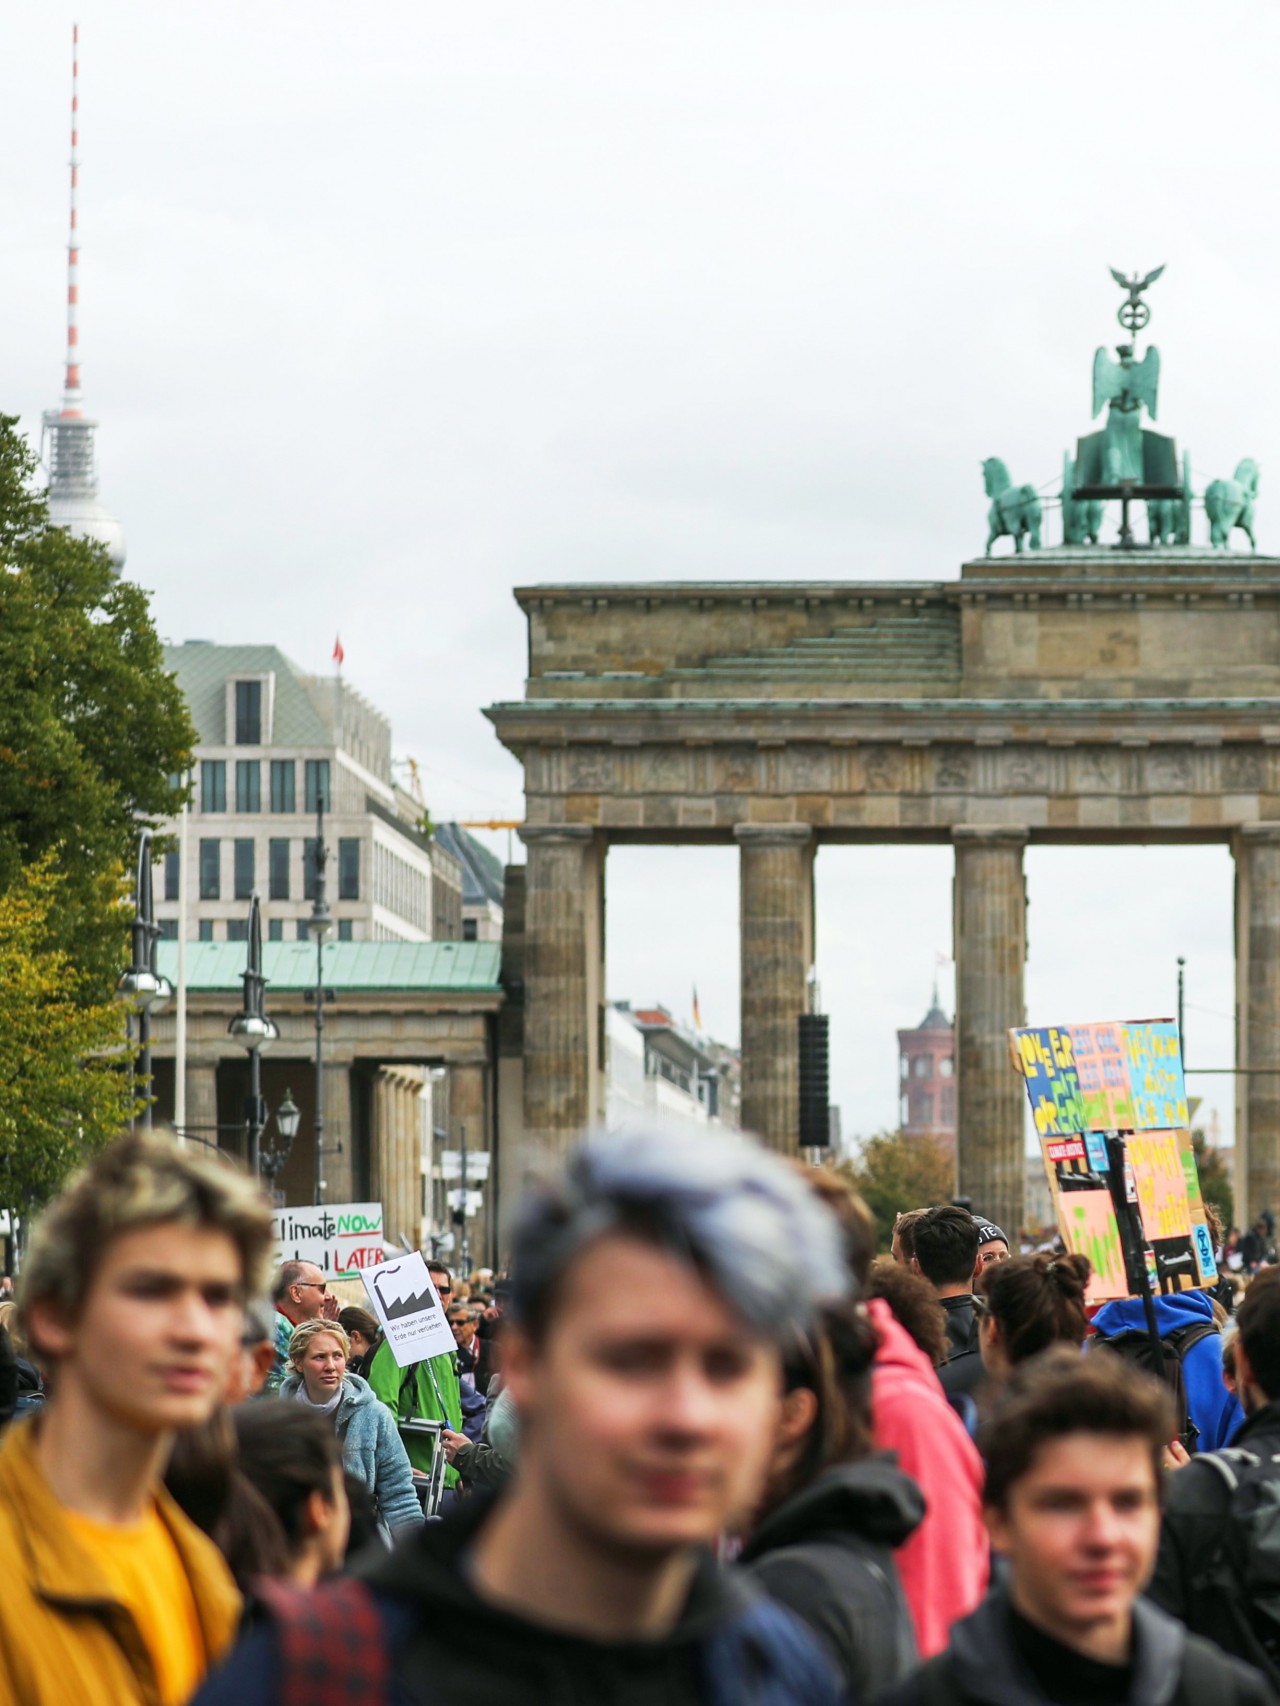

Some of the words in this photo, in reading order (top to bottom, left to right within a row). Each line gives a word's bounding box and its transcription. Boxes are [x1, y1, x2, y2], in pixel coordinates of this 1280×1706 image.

[272, 1211, 336, 1241] limate
[337, 1214, 382, 1233] NOW
[979, 1226, 997, 1244] TE
[334, 1247, 384, 1273] LATER
[390, 1324, 400, 1332] Wir
[400, 1319, 418, 1329] haben
[393, 1332, 407, 1341] Erde
